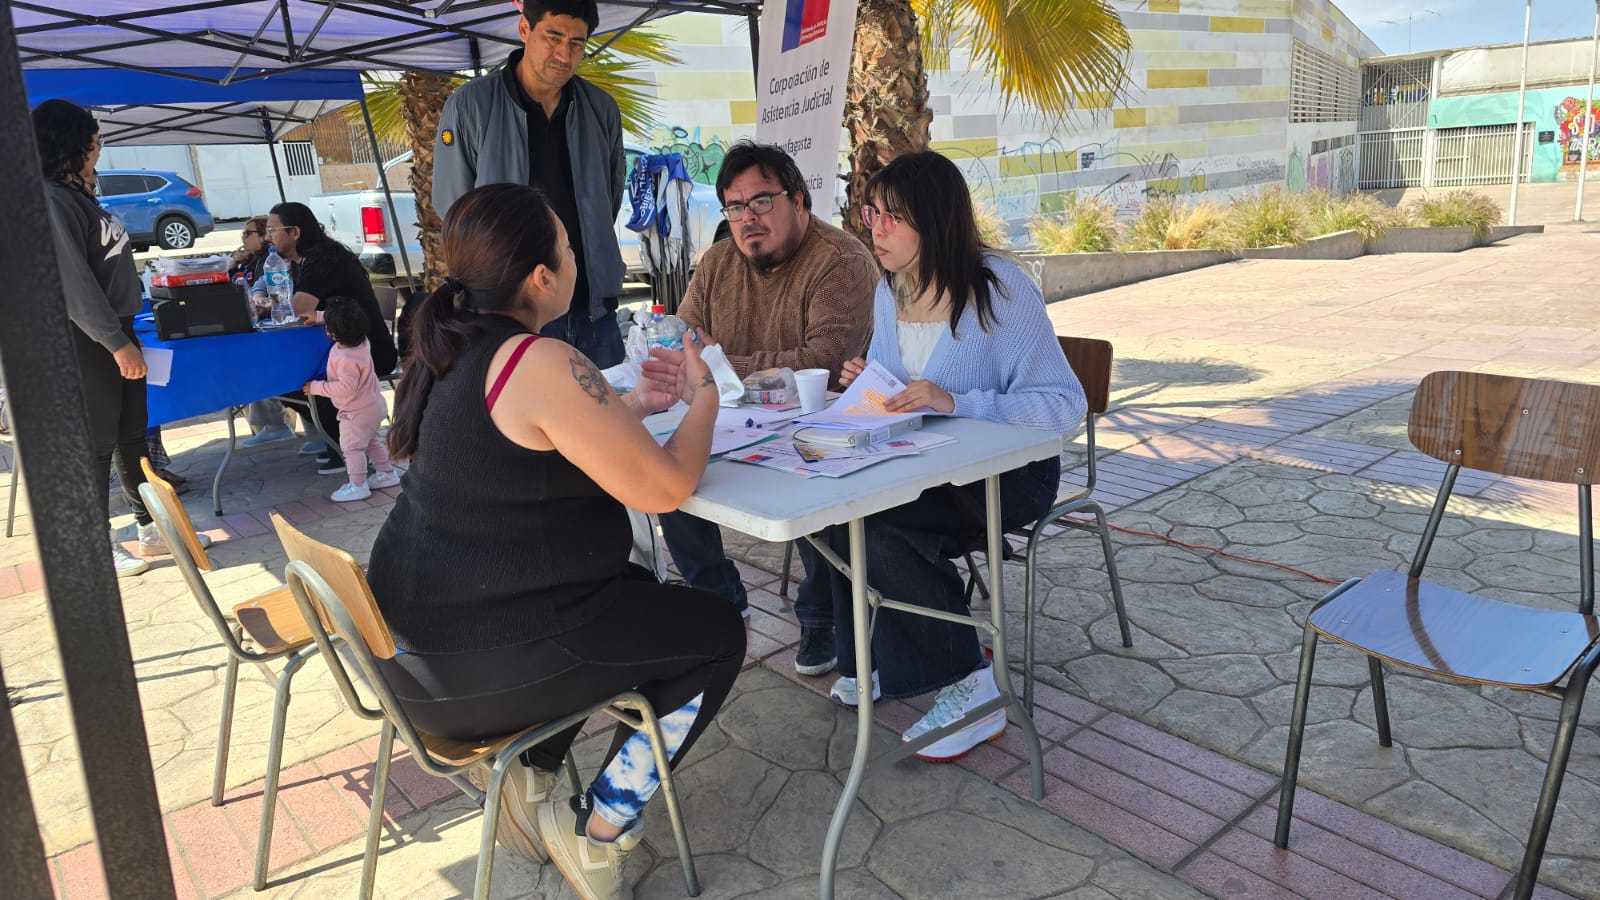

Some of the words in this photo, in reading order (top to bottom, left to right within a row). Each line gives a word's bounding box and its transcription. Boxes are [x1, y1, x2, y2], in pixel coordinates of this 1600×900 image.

[819, 59, 830, 78] de
[761, 98, 800, 125] Asistencia
[801, 85, 834, 114] Judicial
